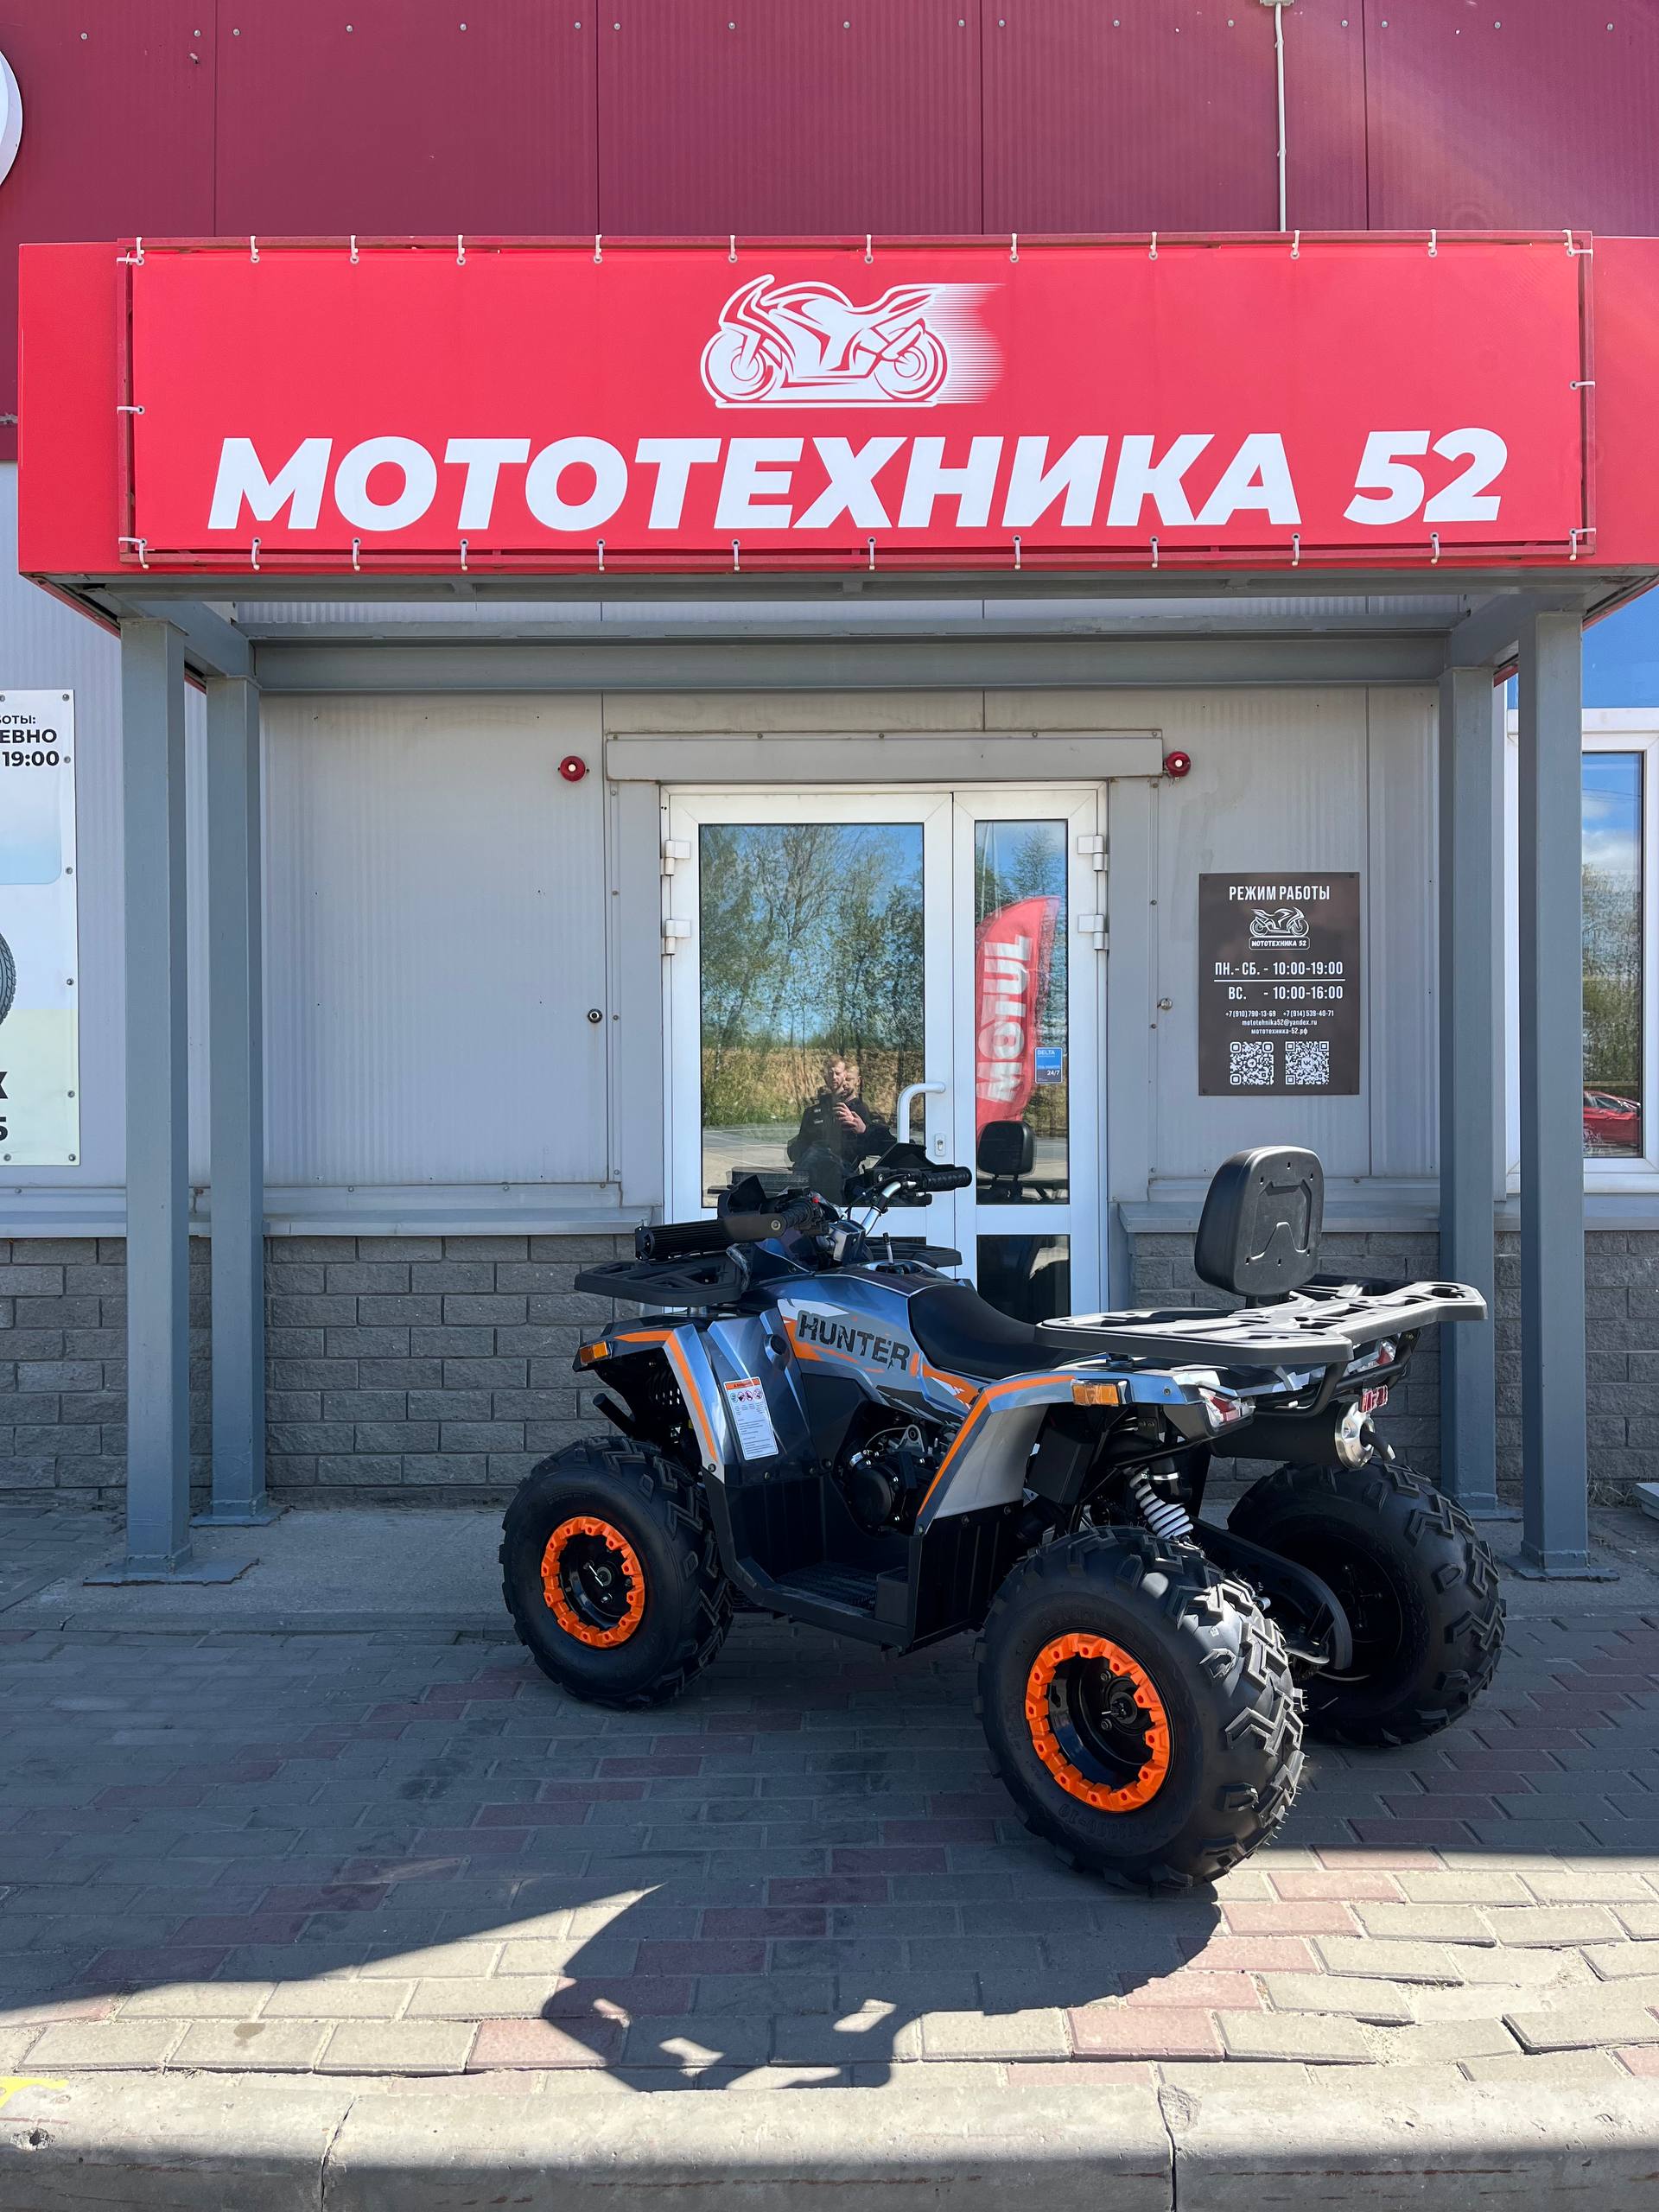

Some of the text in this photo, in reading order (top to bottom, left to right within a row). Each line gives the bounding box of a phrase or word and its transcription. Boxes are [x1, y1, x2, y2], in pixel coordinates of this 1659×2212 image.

[207, 427, 1508, 531] МОТОТЕХНИКА 52
[2, 750, 60, 766] 19:00
[1229, 885, 1331, 900] РЕЖИМ РАБОТЫ
[1273, 961, 1343, 975] 10:00-19:00
[1228, 986, 1247, 1000] ВС.
[1273, 986, 1343, 1000] 10:00-16:00
[976, 934, 1033, 1103] MOTUL
[797, 1313, 912, 1372] HUNTER
